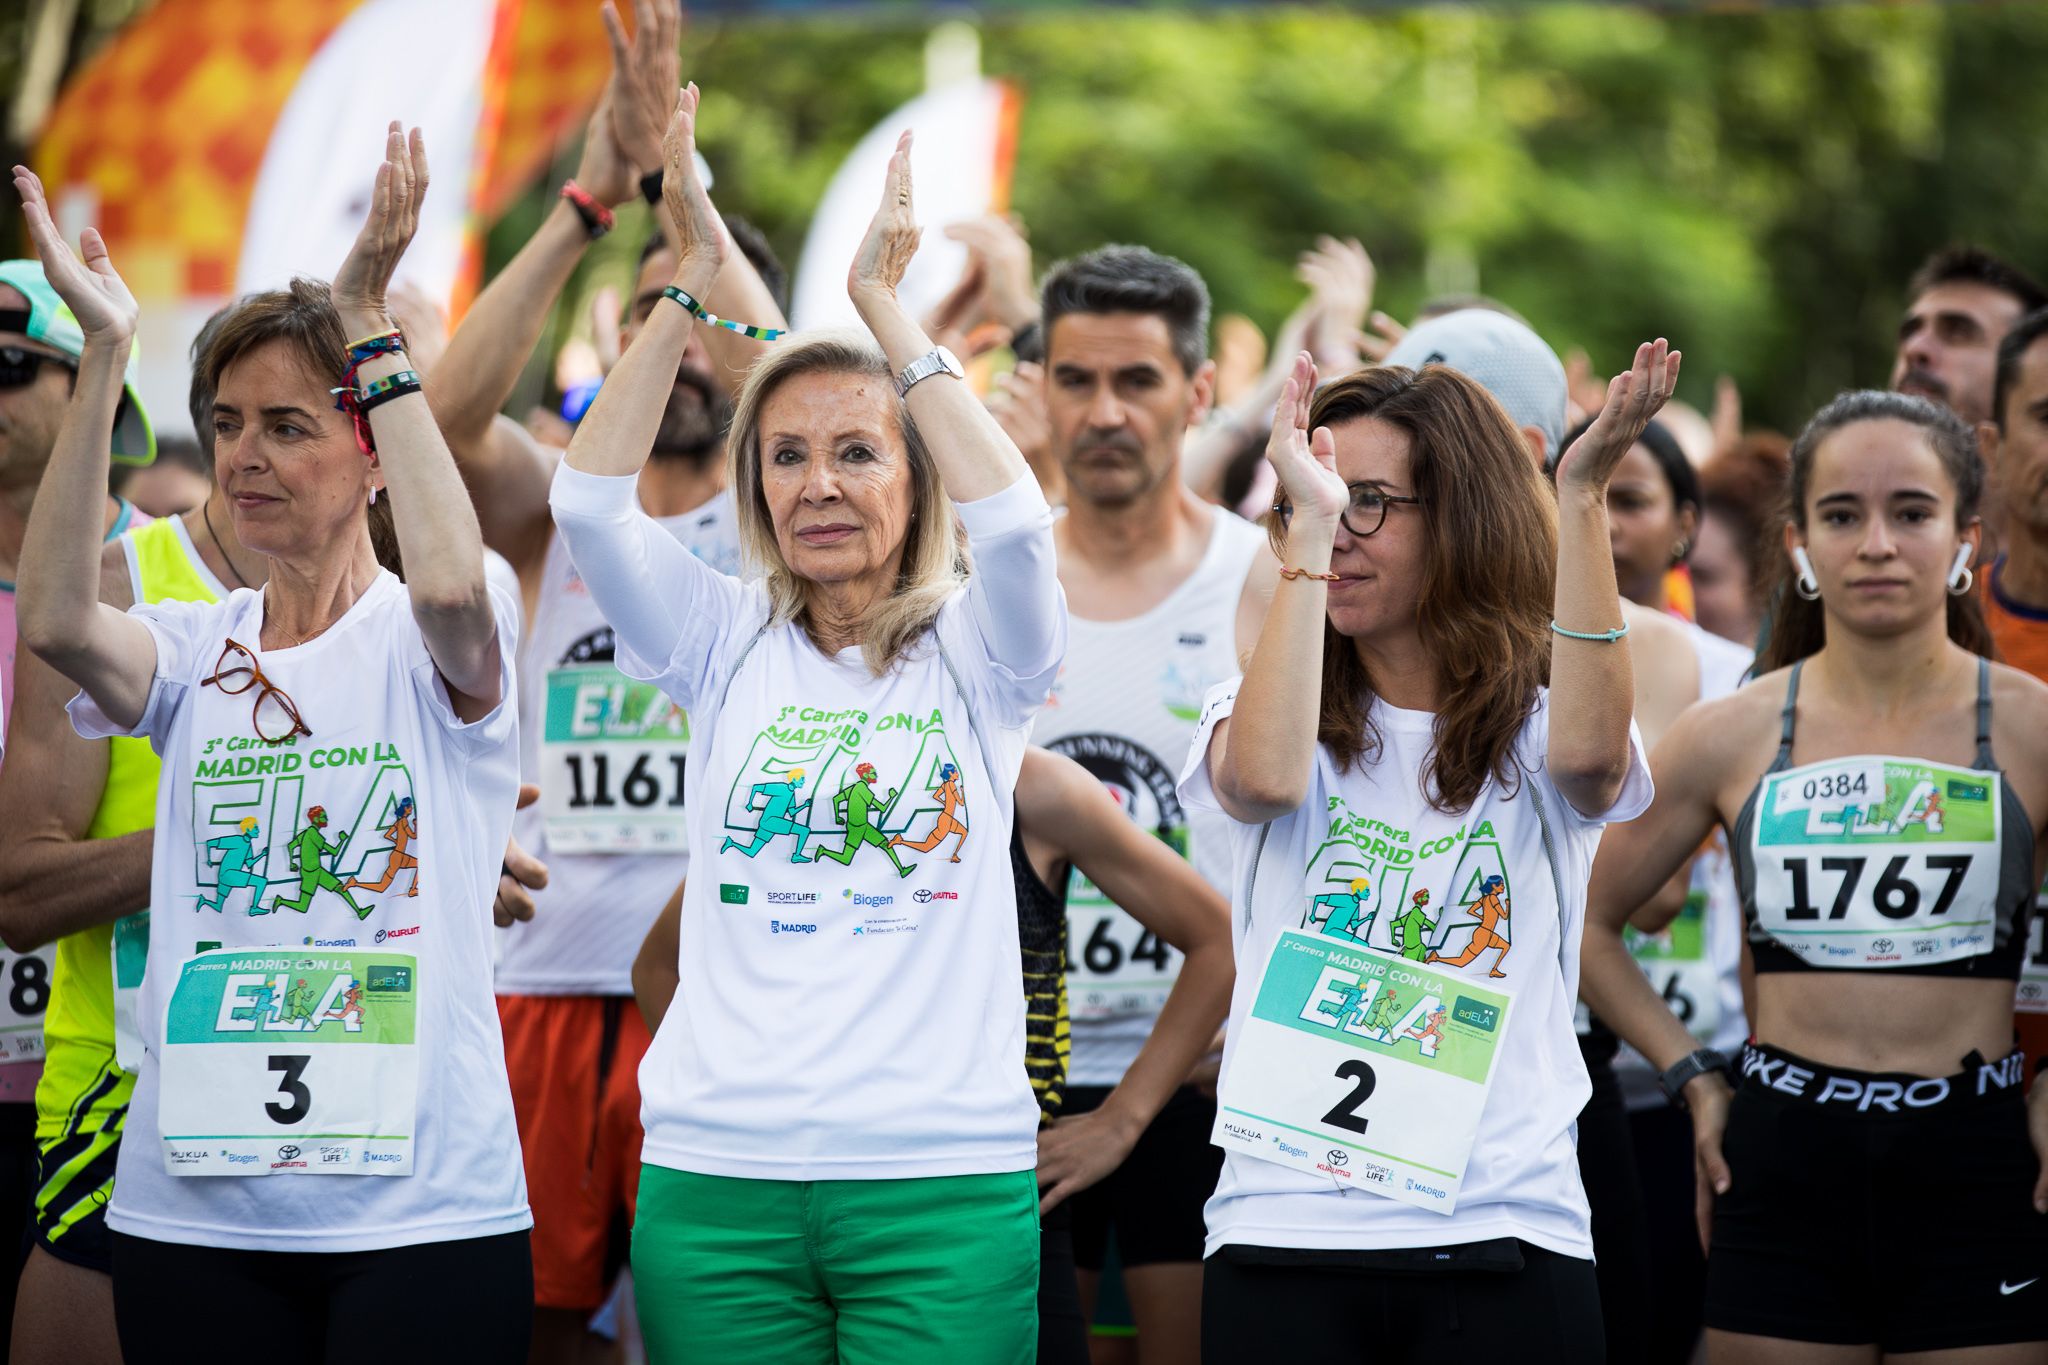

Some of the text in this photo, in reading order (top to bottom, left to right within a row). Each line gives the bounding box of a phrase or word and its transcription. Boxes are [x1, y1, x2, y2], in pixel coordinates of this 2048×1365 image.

[767, 724, 861, 748] MADRID
[916, 708, 944, 734] LA
[195, 742, 401, 779] MADRID CON LA
[565, 753, 687, 809] 1161
[724, 729, 969, 835] ELA
[1915, 768, 1935, 780] LA
[1802, 772, 1869, 801] 0384
[192, 764, 418, 888] ELA
[1347, 810, 1410, 843] Carrera
[1326, 817, 1415, 865] MADRID
[1418, 823, 1467, 860] CON
[1783, 855, 1974, 921] 1767
[853, 893, 894, 908] Biogen
[781, 923, 817, 934] MADRID
[1916, 946, 1933, 954] LIFE
[195, 963, 228, 971] Carrera
[230, 959, 291, 972] MADRID
[295, 959, 331, 971] CON
[332, 959, 353, 971] LA
[1293, 941, 1325, 958] Carrera
[1326, 950, 1387, 978] MADRID
[1389, 969, 1424, 989] CON
[1424, 979, 1444, 995] LA
[0, 955, 51, 1018] 8
[214, 973, 363, 1033] ELA
[1298, 964, 1443, 1059] ELA
[1458, 1009, 1490, 1026] adELA
[264, 1054, 313, 1125] 3
[1321, 1059, 1377, 1135] 2
[1815, 1073, 1951, 1113] PRO
[1224, 1123, 1262, 1140] MUKUA
[170, 1151, 210, 1159] MUKUA
[228, 1153, 260, 1165] Biogen
[319, 1146, 346, 1155] SPORT
[322, 1154, 341, 1163] LIFE
[371, 1154, 403, 1164] MADRID
[1278, 1142, 1309, 1158] Biogen
[1365, 1162, 1390, 1175] SPORT
[1366, 1171, 1385, 1183] LIFE
[1413, 1183, 1447, 1199] MADRID
